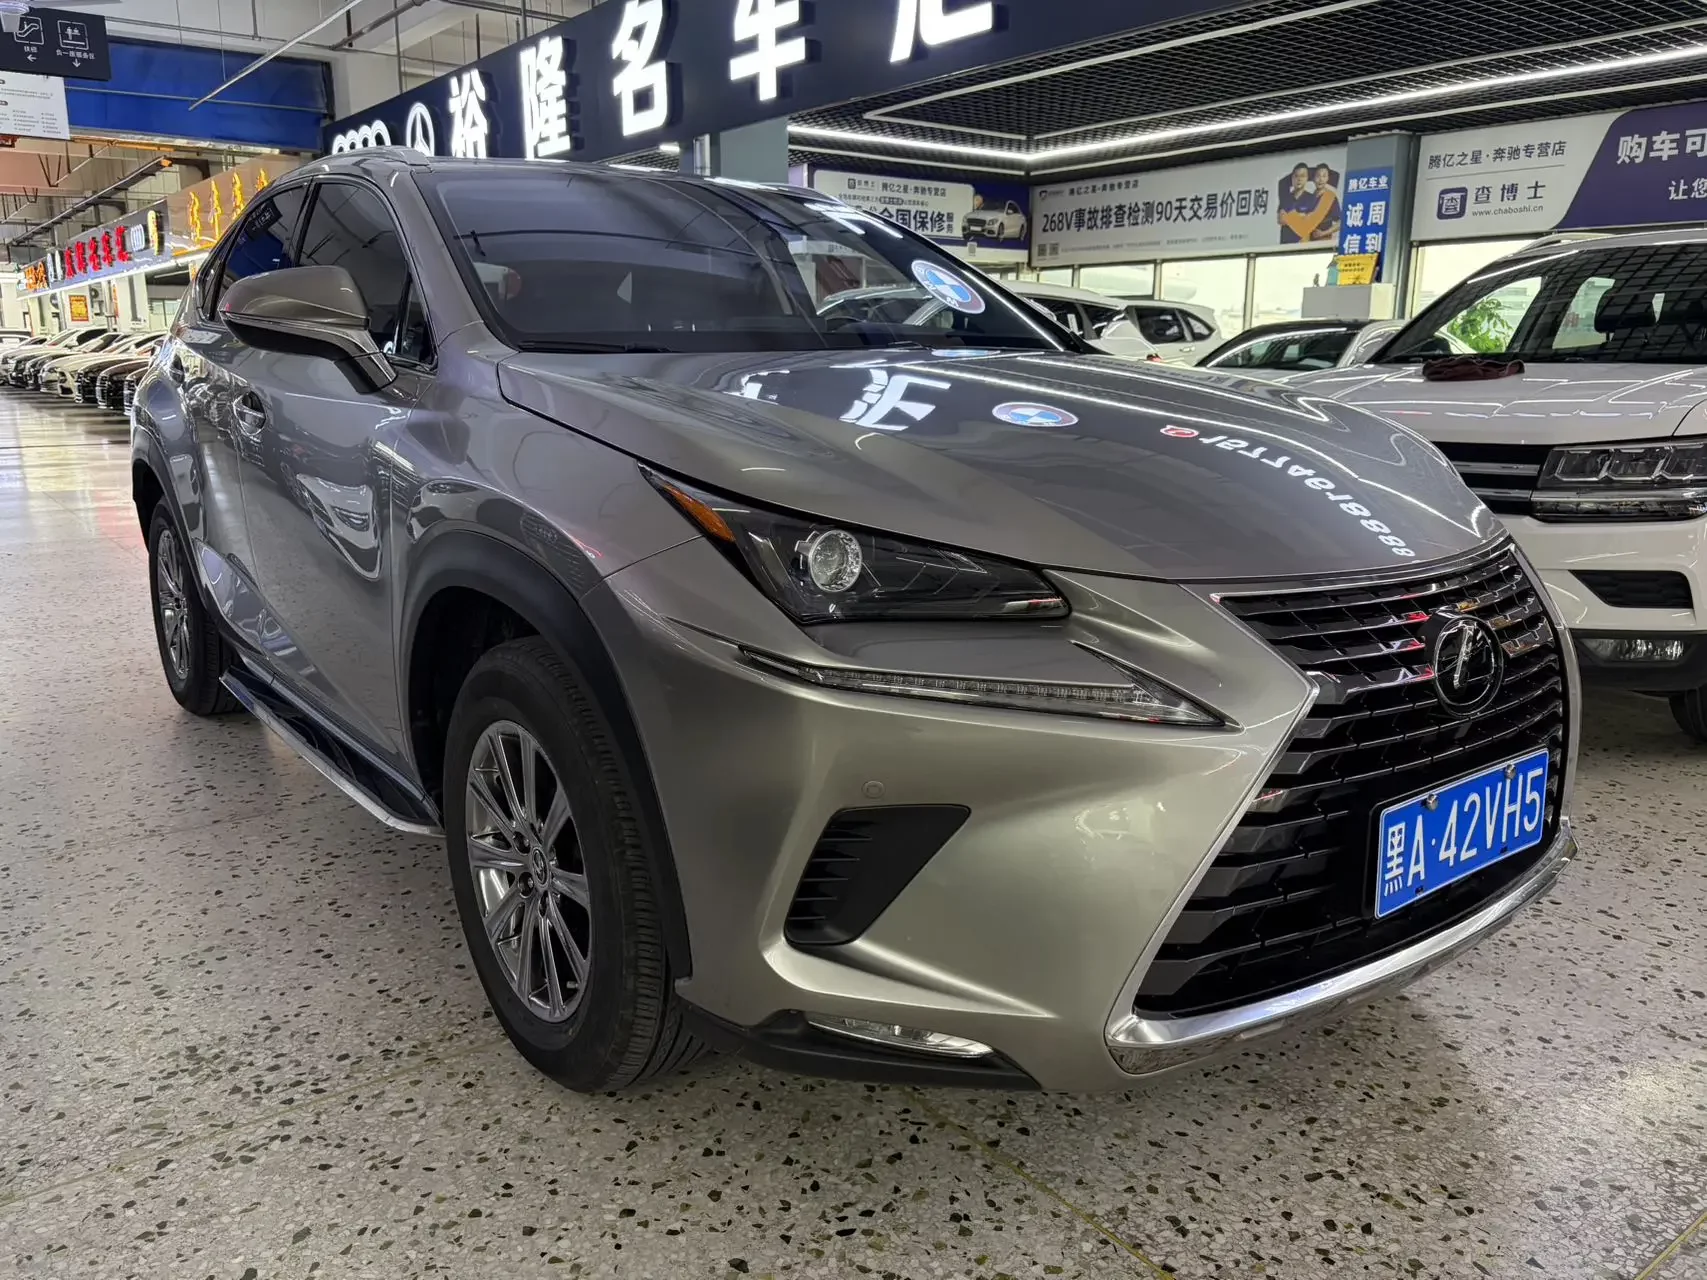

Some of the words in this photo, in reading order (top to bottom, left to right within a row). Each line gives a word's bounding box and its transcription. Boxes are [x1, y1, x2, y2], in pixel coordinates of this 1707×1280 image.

[1428, 141, 1567, 169] 腾亿之星·奔驰专营店
[1616, 128, 1707, 164] 购车可
[1473, 181, 1546, 205] 查博士
[1472, 204, 1544, 217] www.chaboshi.cn
